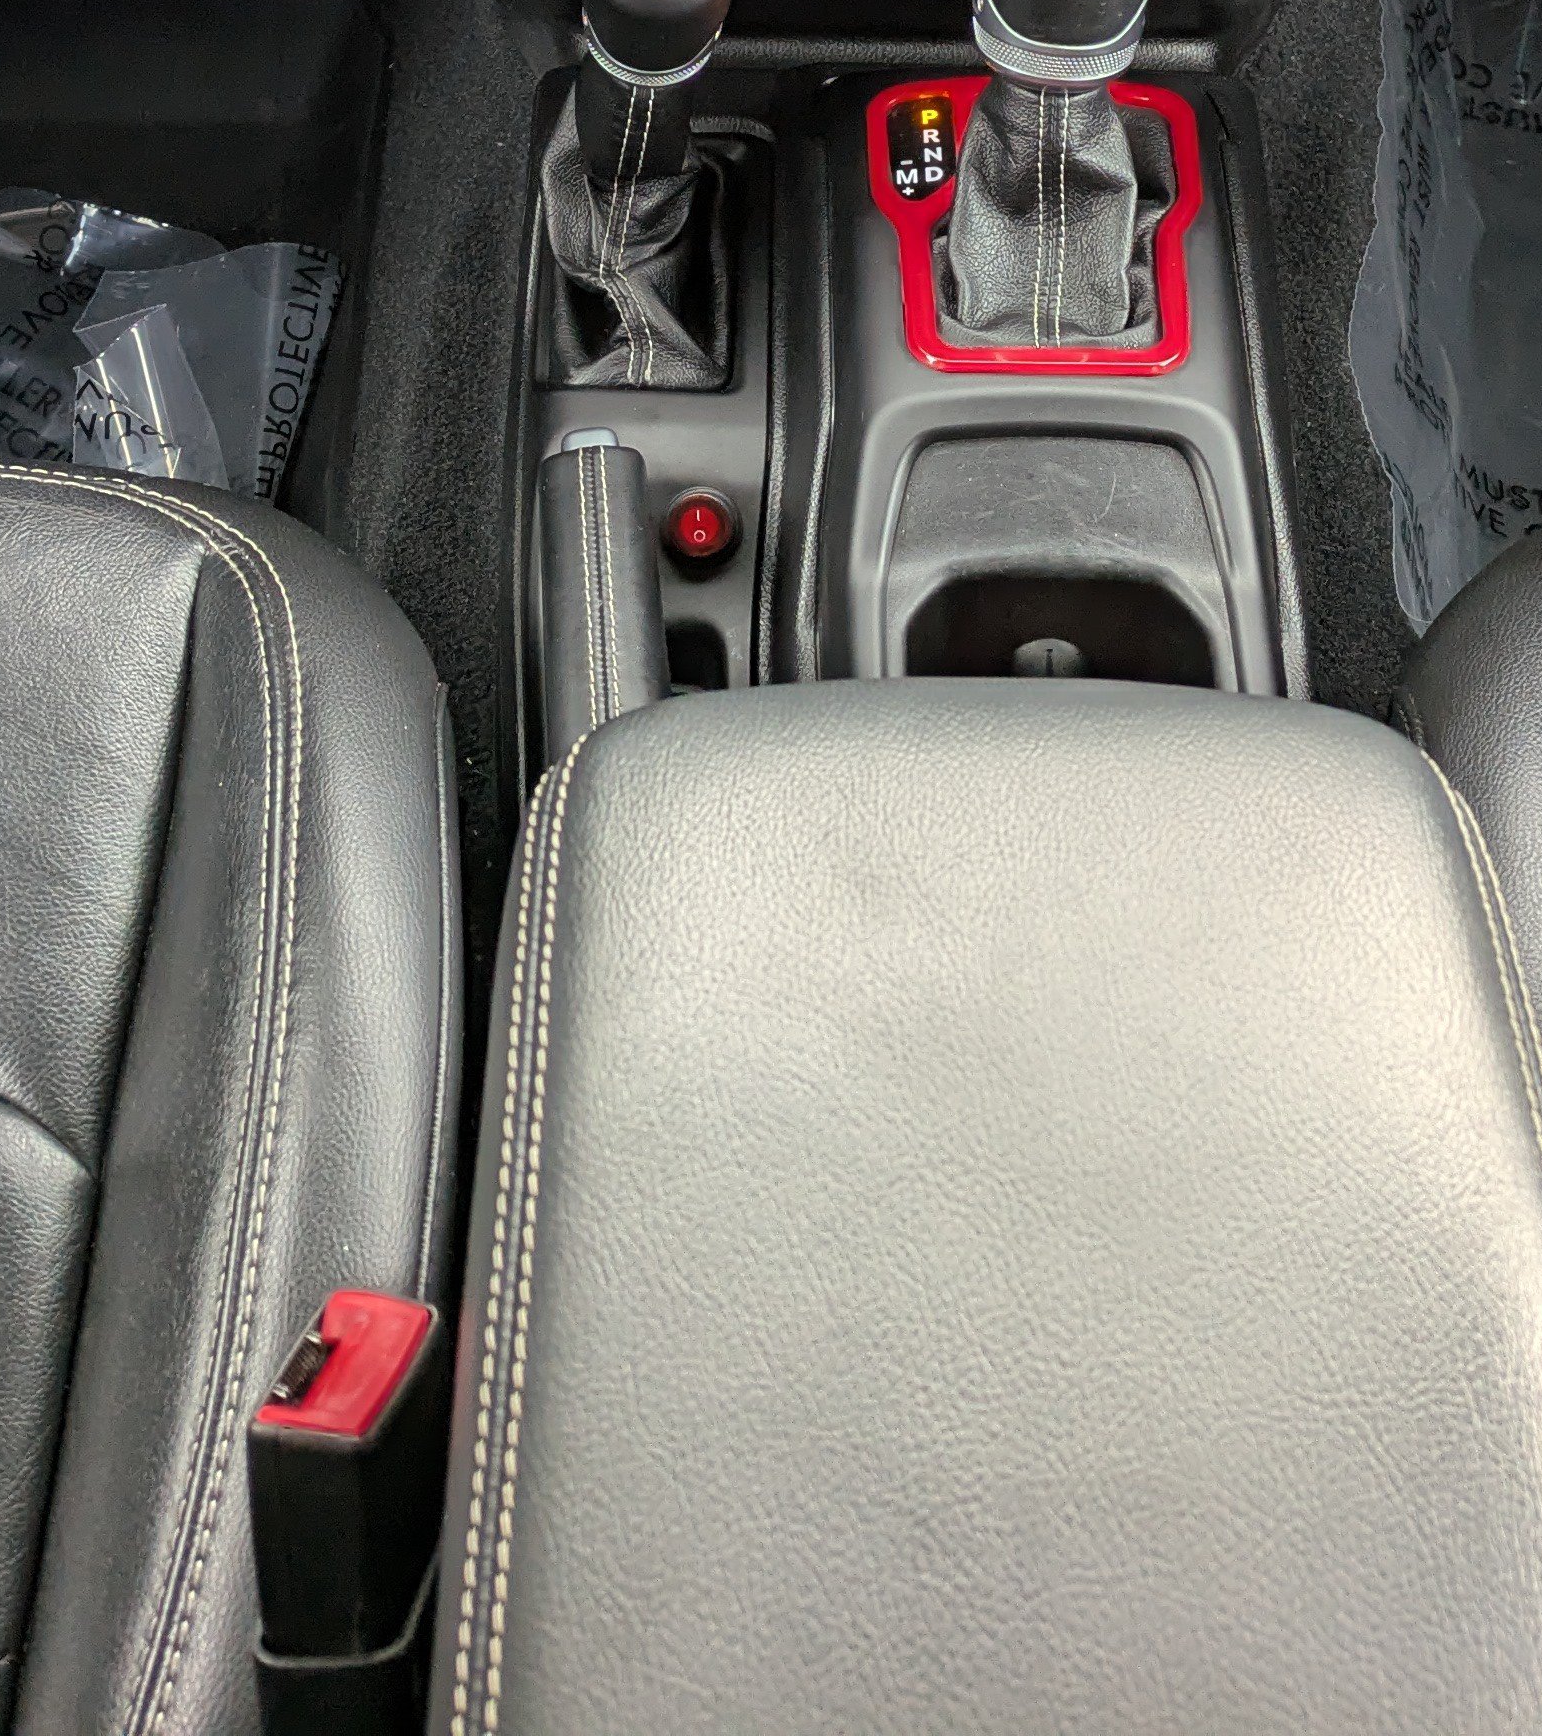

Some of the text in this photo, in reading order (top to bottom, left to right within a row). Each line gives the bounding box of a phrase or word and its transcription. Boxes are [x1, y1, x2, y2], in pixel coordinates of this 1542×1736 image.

[921, 109, 939, 126] P
[922, 128, 940, 144] R
[923, 147, 943, 162] N
[896, 169, 919, 185] M
[925, 166, 944, 183] D
